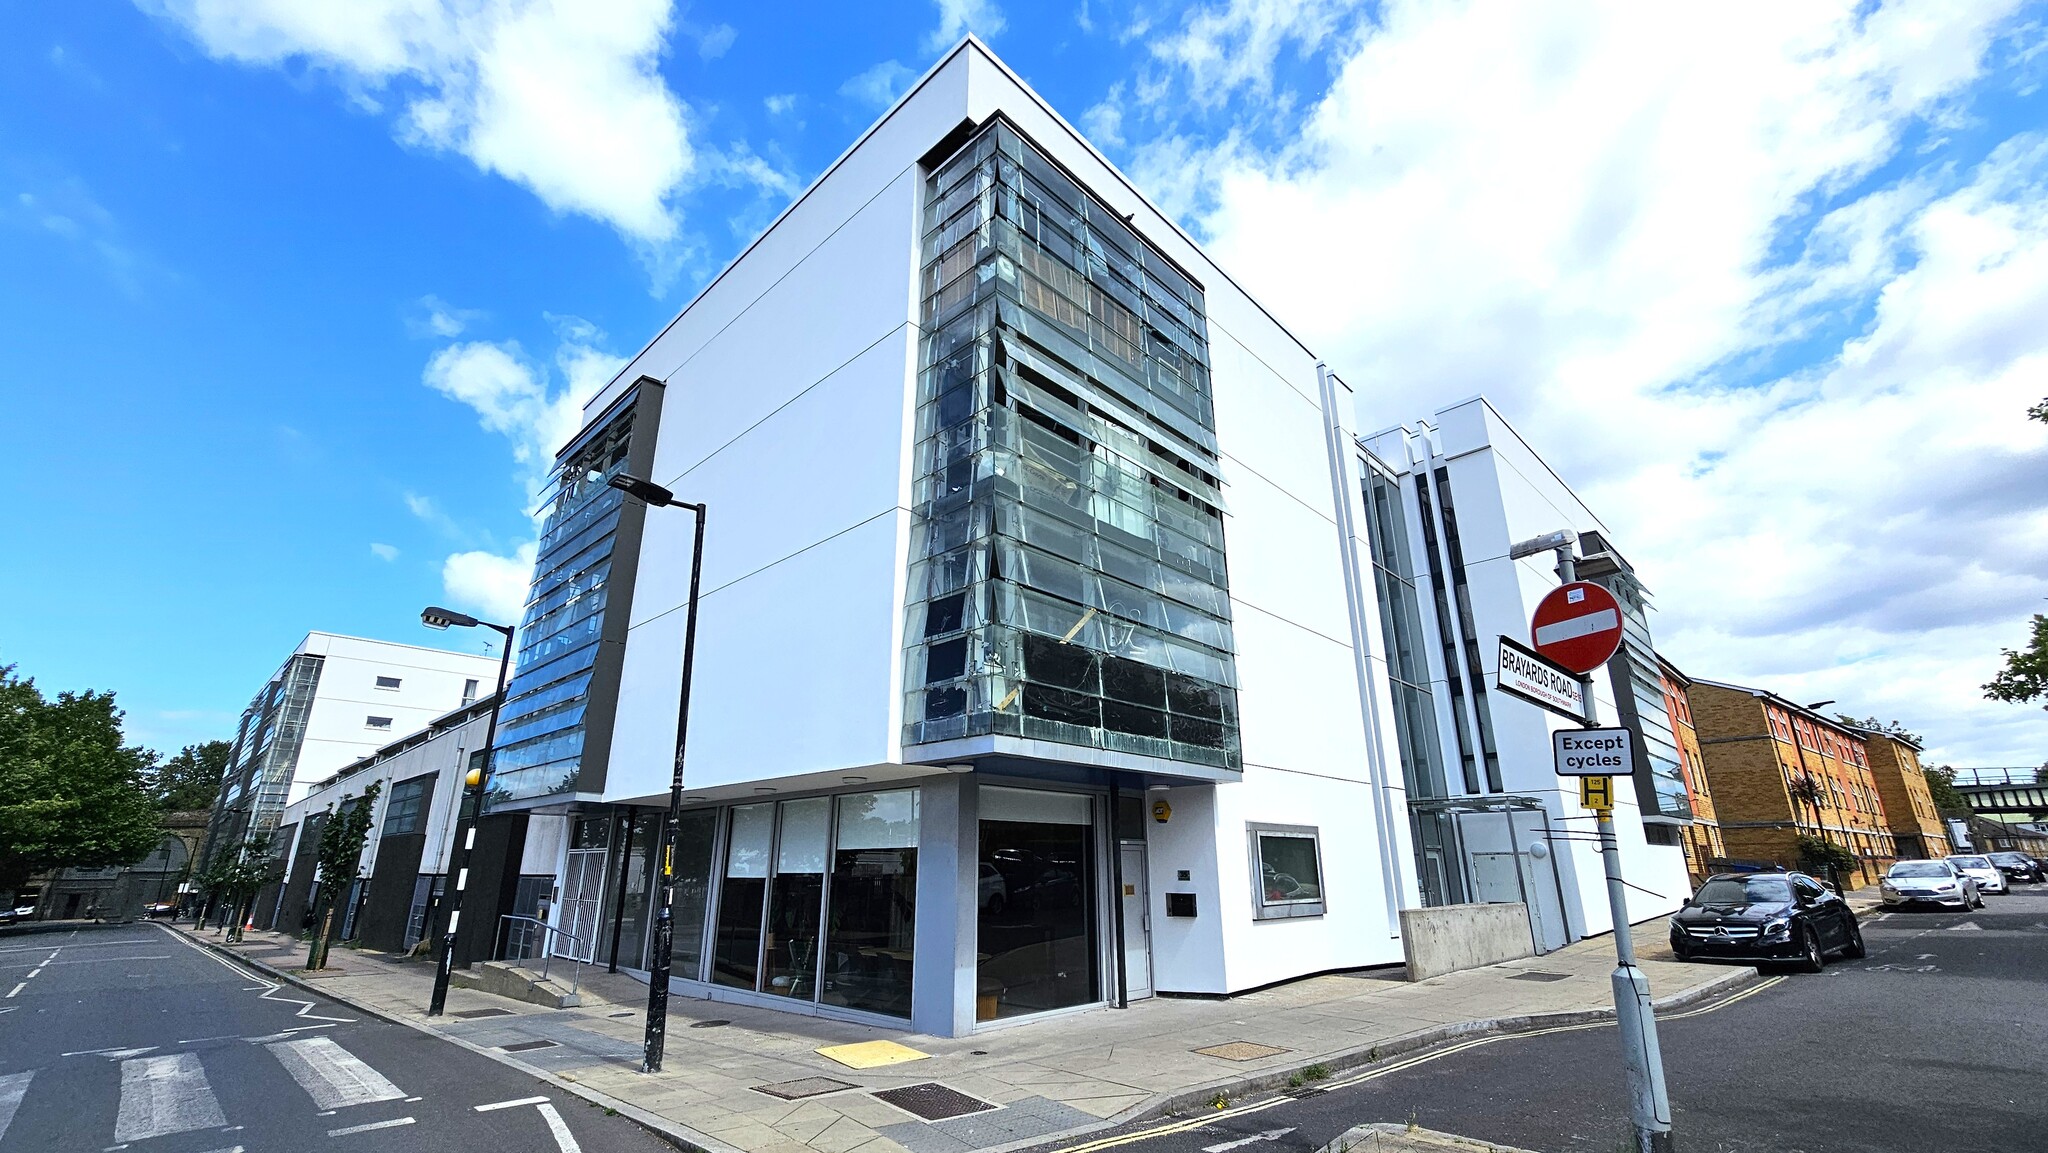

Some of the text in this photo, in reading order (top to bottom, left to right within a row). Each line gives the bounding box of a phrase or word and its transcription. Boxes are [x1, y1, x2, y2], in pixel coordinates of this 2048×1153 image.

[1502, 649, 1548, 687] BRAYARDS
[1550, 673, 1572, 698] ROAD
[1515, 680, 1530, 691] LONDON
[1531, 686, 1547, 698] BOROUGH
[1563, 736, 1624, 751] Except
[1566, 753, 1622, 769] cycles
[1583, 777, 1609, 806] H
